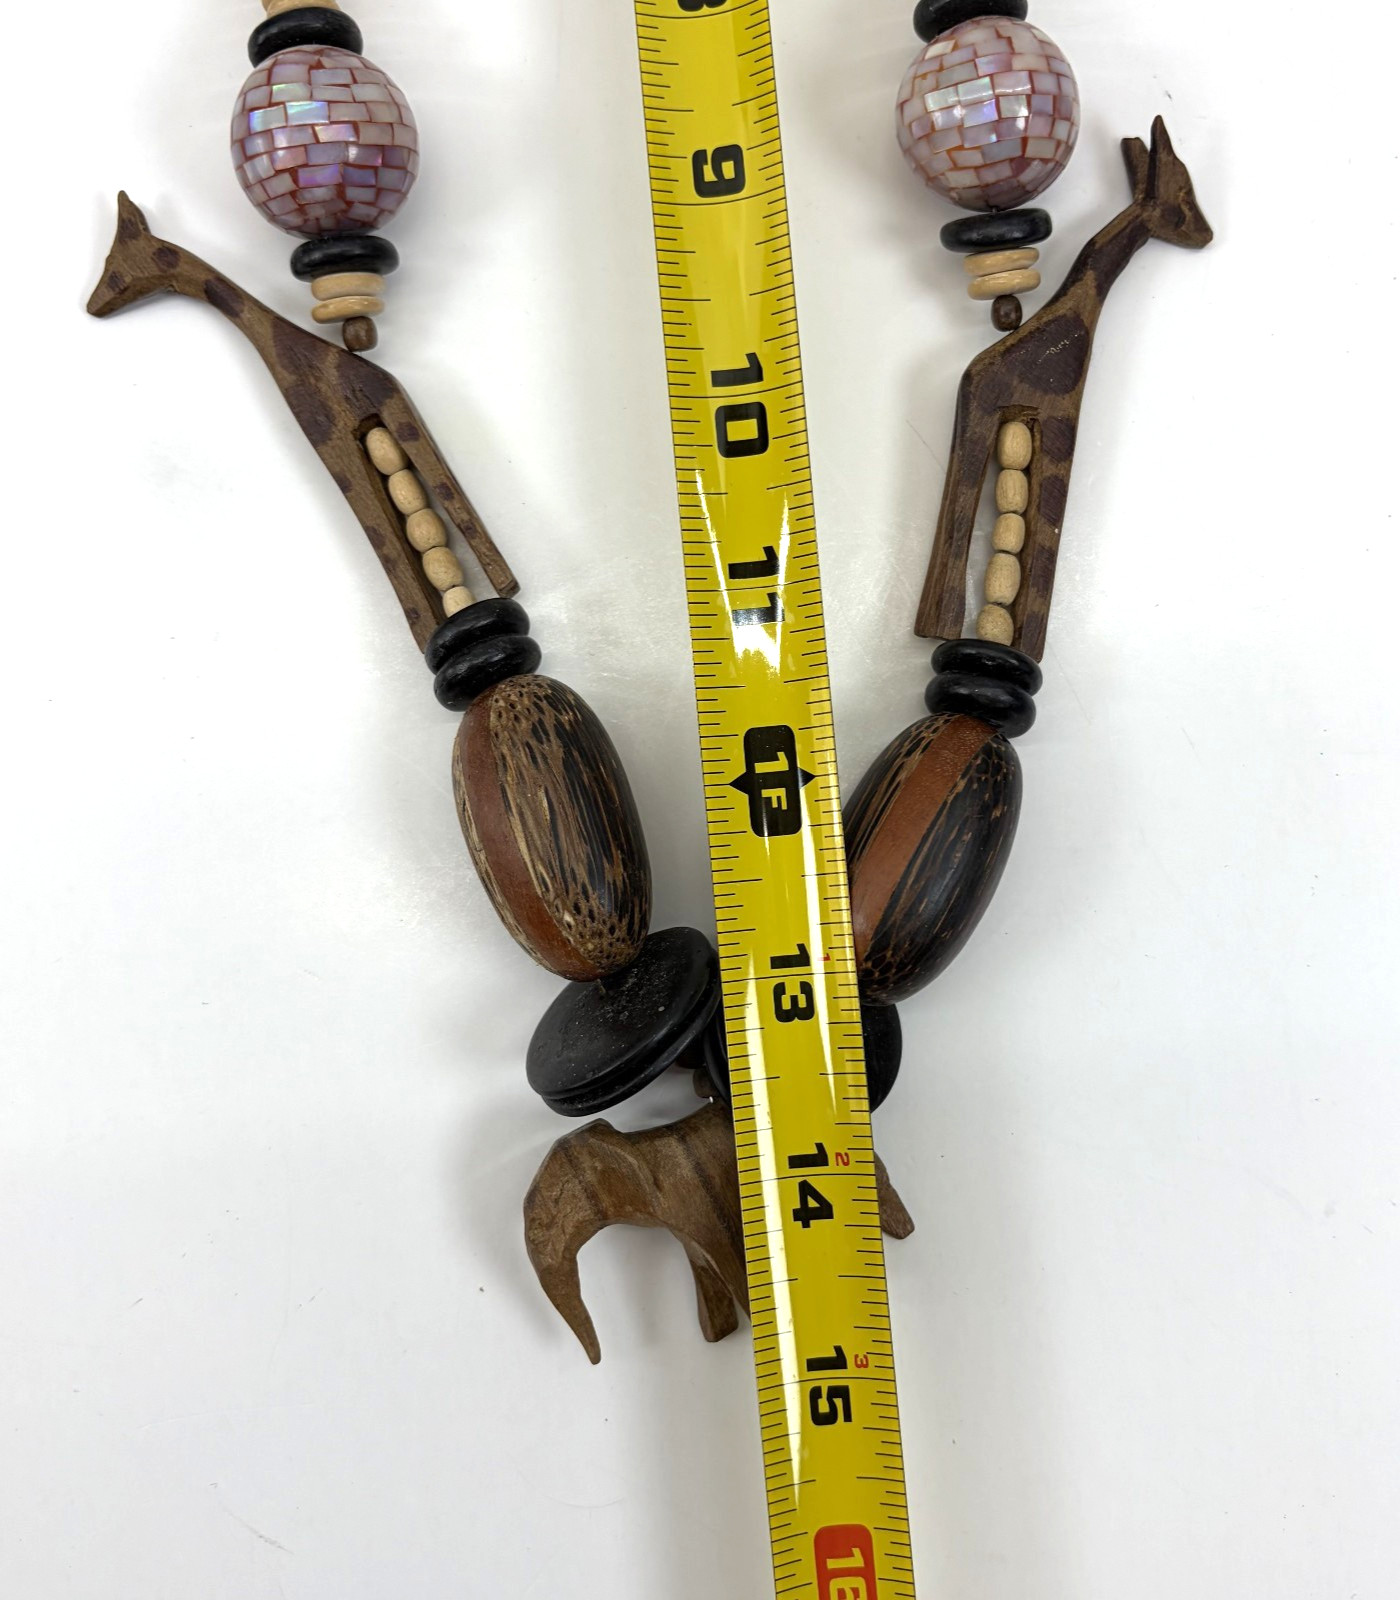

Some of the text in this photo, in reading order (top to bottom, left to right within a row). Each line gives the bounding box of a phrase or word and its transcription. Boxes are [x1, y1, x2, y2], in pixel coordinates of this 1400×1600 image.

[692, 144, 746, 198] 9
[710, 352, 769, 458] 10
[728, 545, 785, 627] 11
[770, 942, 815, 1024] 13
[787, 1142, 834, 1229] 14
[834, 1151, 850, 1167] 2
[806, 1345, 853, 1426] 15
[854, 1353, 869, 1369] 3
